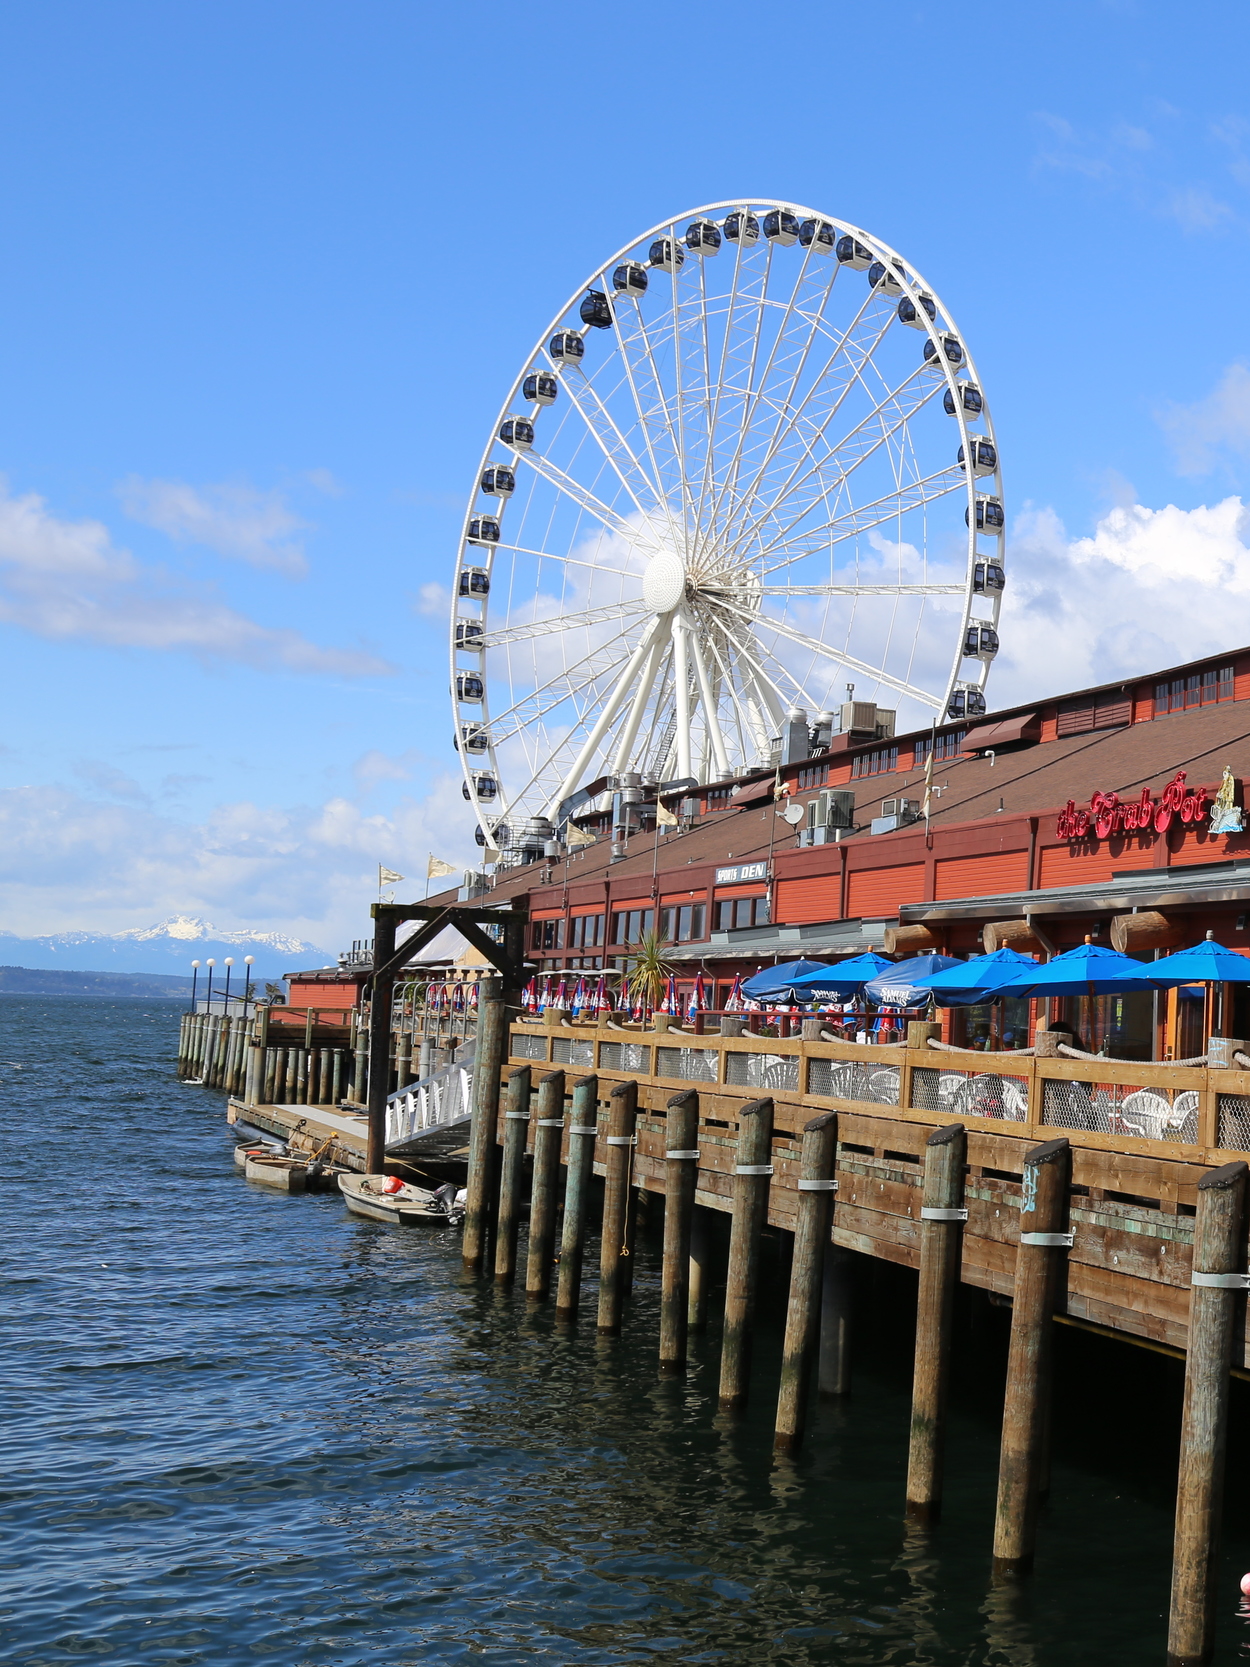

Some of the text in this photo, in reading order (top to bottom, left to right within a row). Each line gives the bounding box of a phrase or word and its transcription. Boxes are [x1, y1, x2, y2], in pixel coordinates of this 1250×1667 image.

[1055, 770, 1208, 839] the Crab Pot
[717, 864, 764, 882] SPORTS DEN
[880, 987, 911, 1000] SAMUEL
[881, 995, 907, 1007] ADAMS
